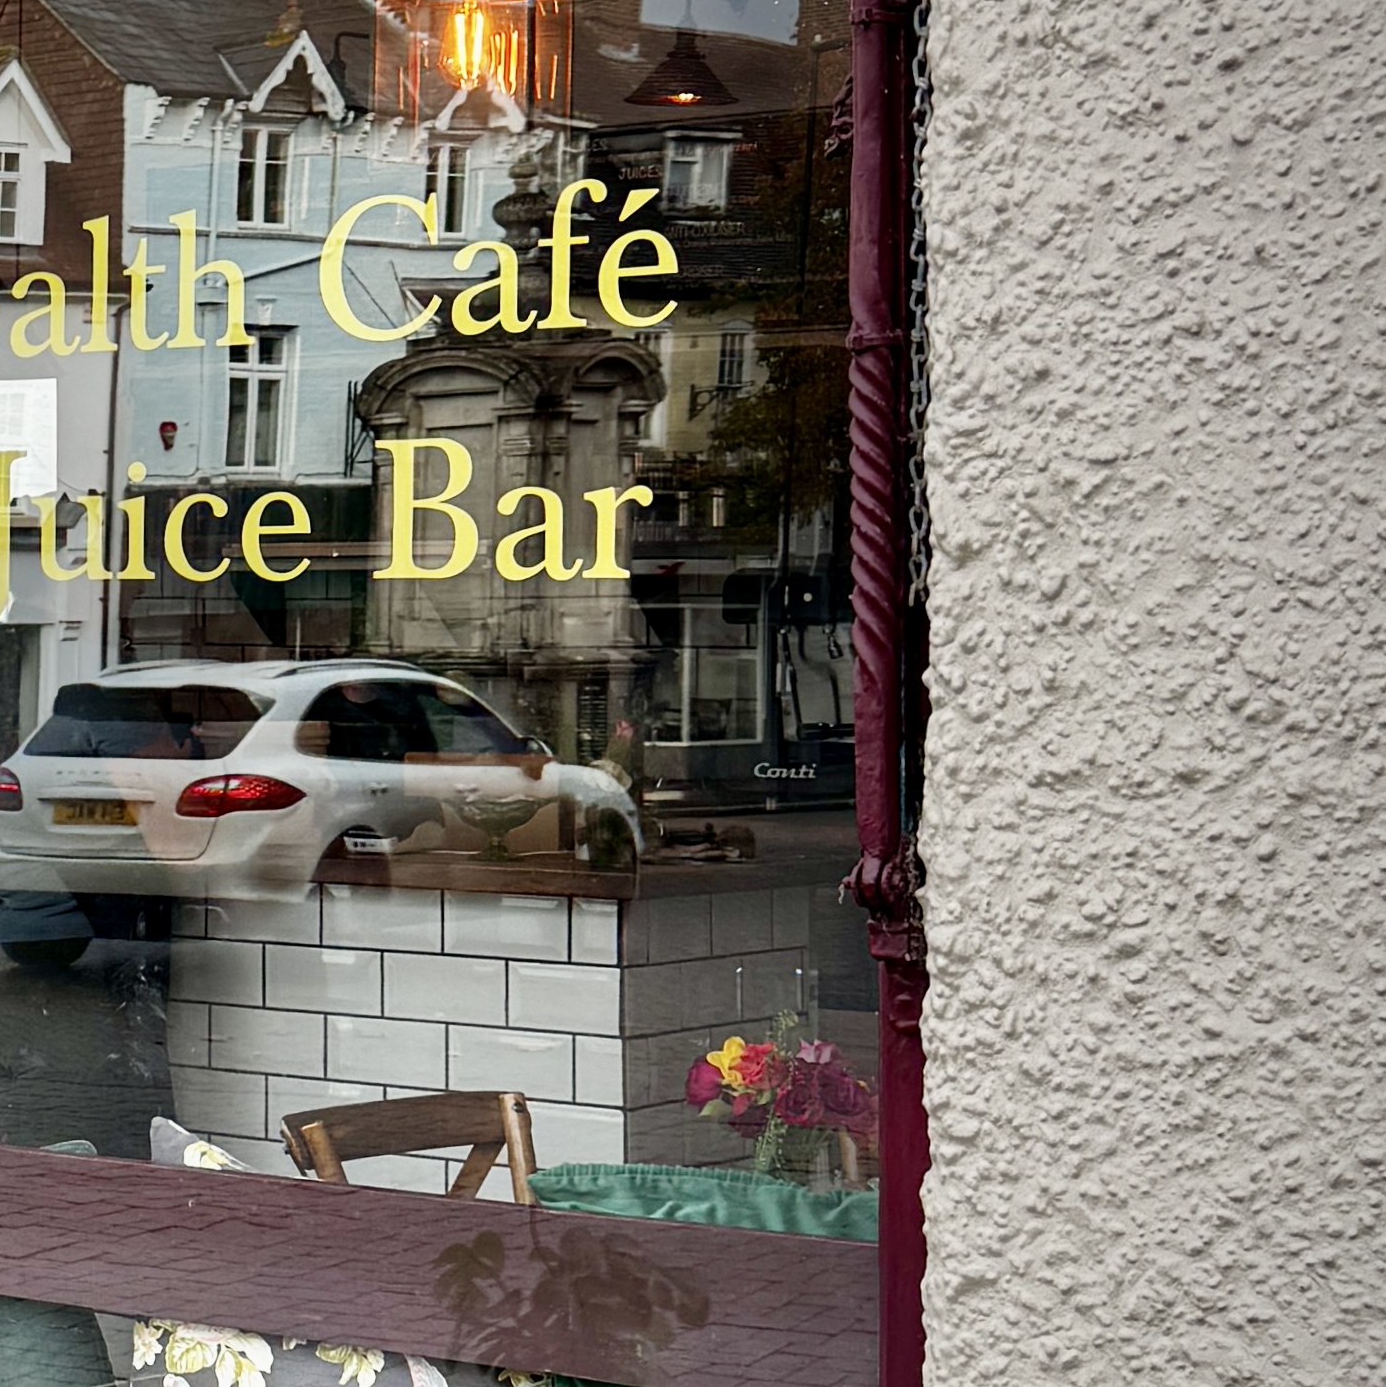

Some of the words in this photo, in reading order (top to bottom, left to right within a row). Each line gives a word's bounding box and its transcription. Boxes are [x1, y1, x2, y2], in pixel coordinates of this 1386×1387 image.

[318, 178, 678, 342] Café
[371, 438, 652, 583] Bar
[753, 762, 817, 779] Conti
